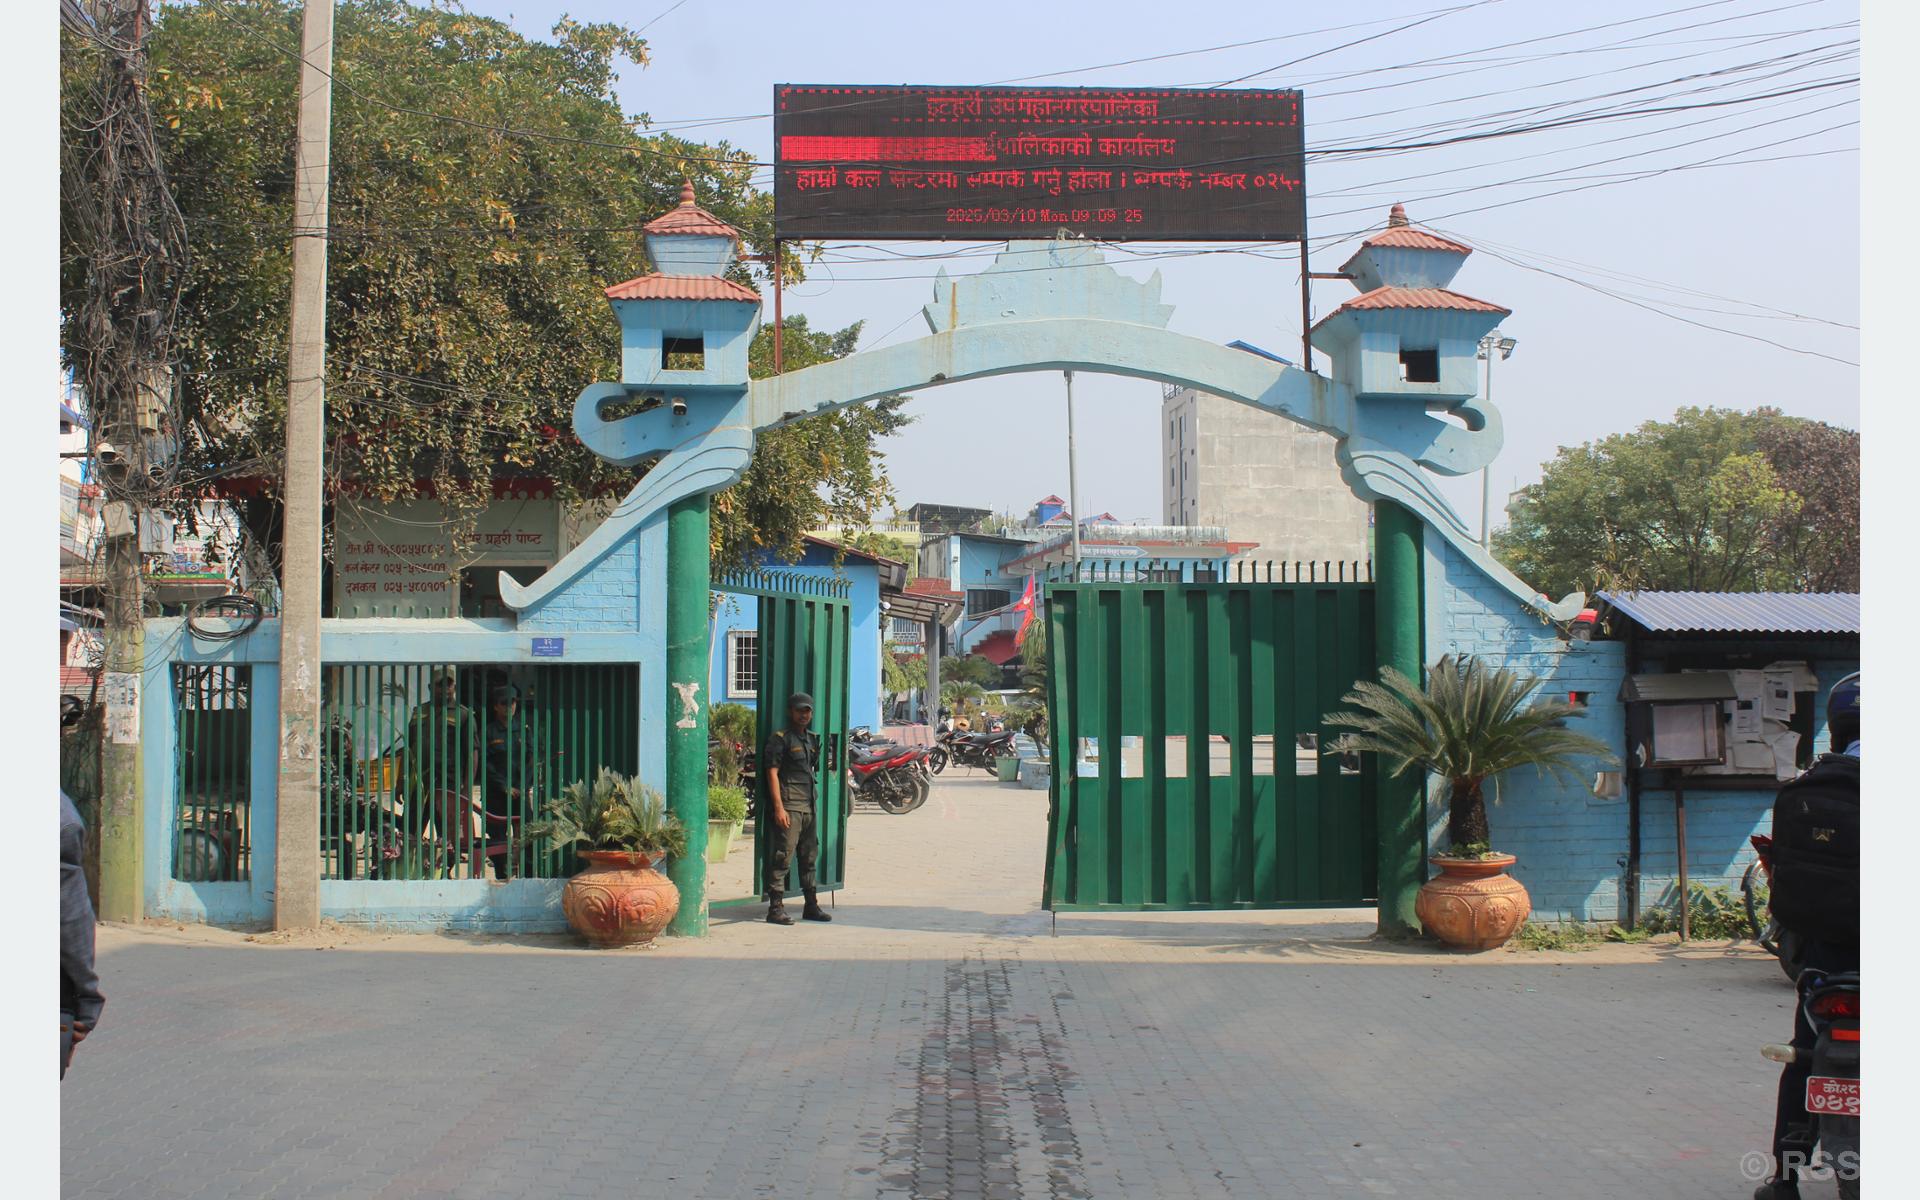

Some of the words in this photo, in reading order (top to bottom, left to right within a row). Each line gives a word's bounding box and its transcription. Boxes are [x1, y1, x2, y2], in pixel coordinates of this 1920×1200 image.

[1098, 132, 1176, 156] कार्यालय
[796, 166, 838, 191] हाम्रो
[844, 169, 882, 189] कल
[1032, 168, 1061, 196] गर्नु
[1067, 167, 1112, 192] होला
[1200, 172, 1247, 189] नम्बर
[946, 207, 1036, 224] 2025/03/10
[1040, 208, 1069, 222] Mon
[485, 529, 512, 548] प्रहरी
[346, 581, 377, 597] दमकल
